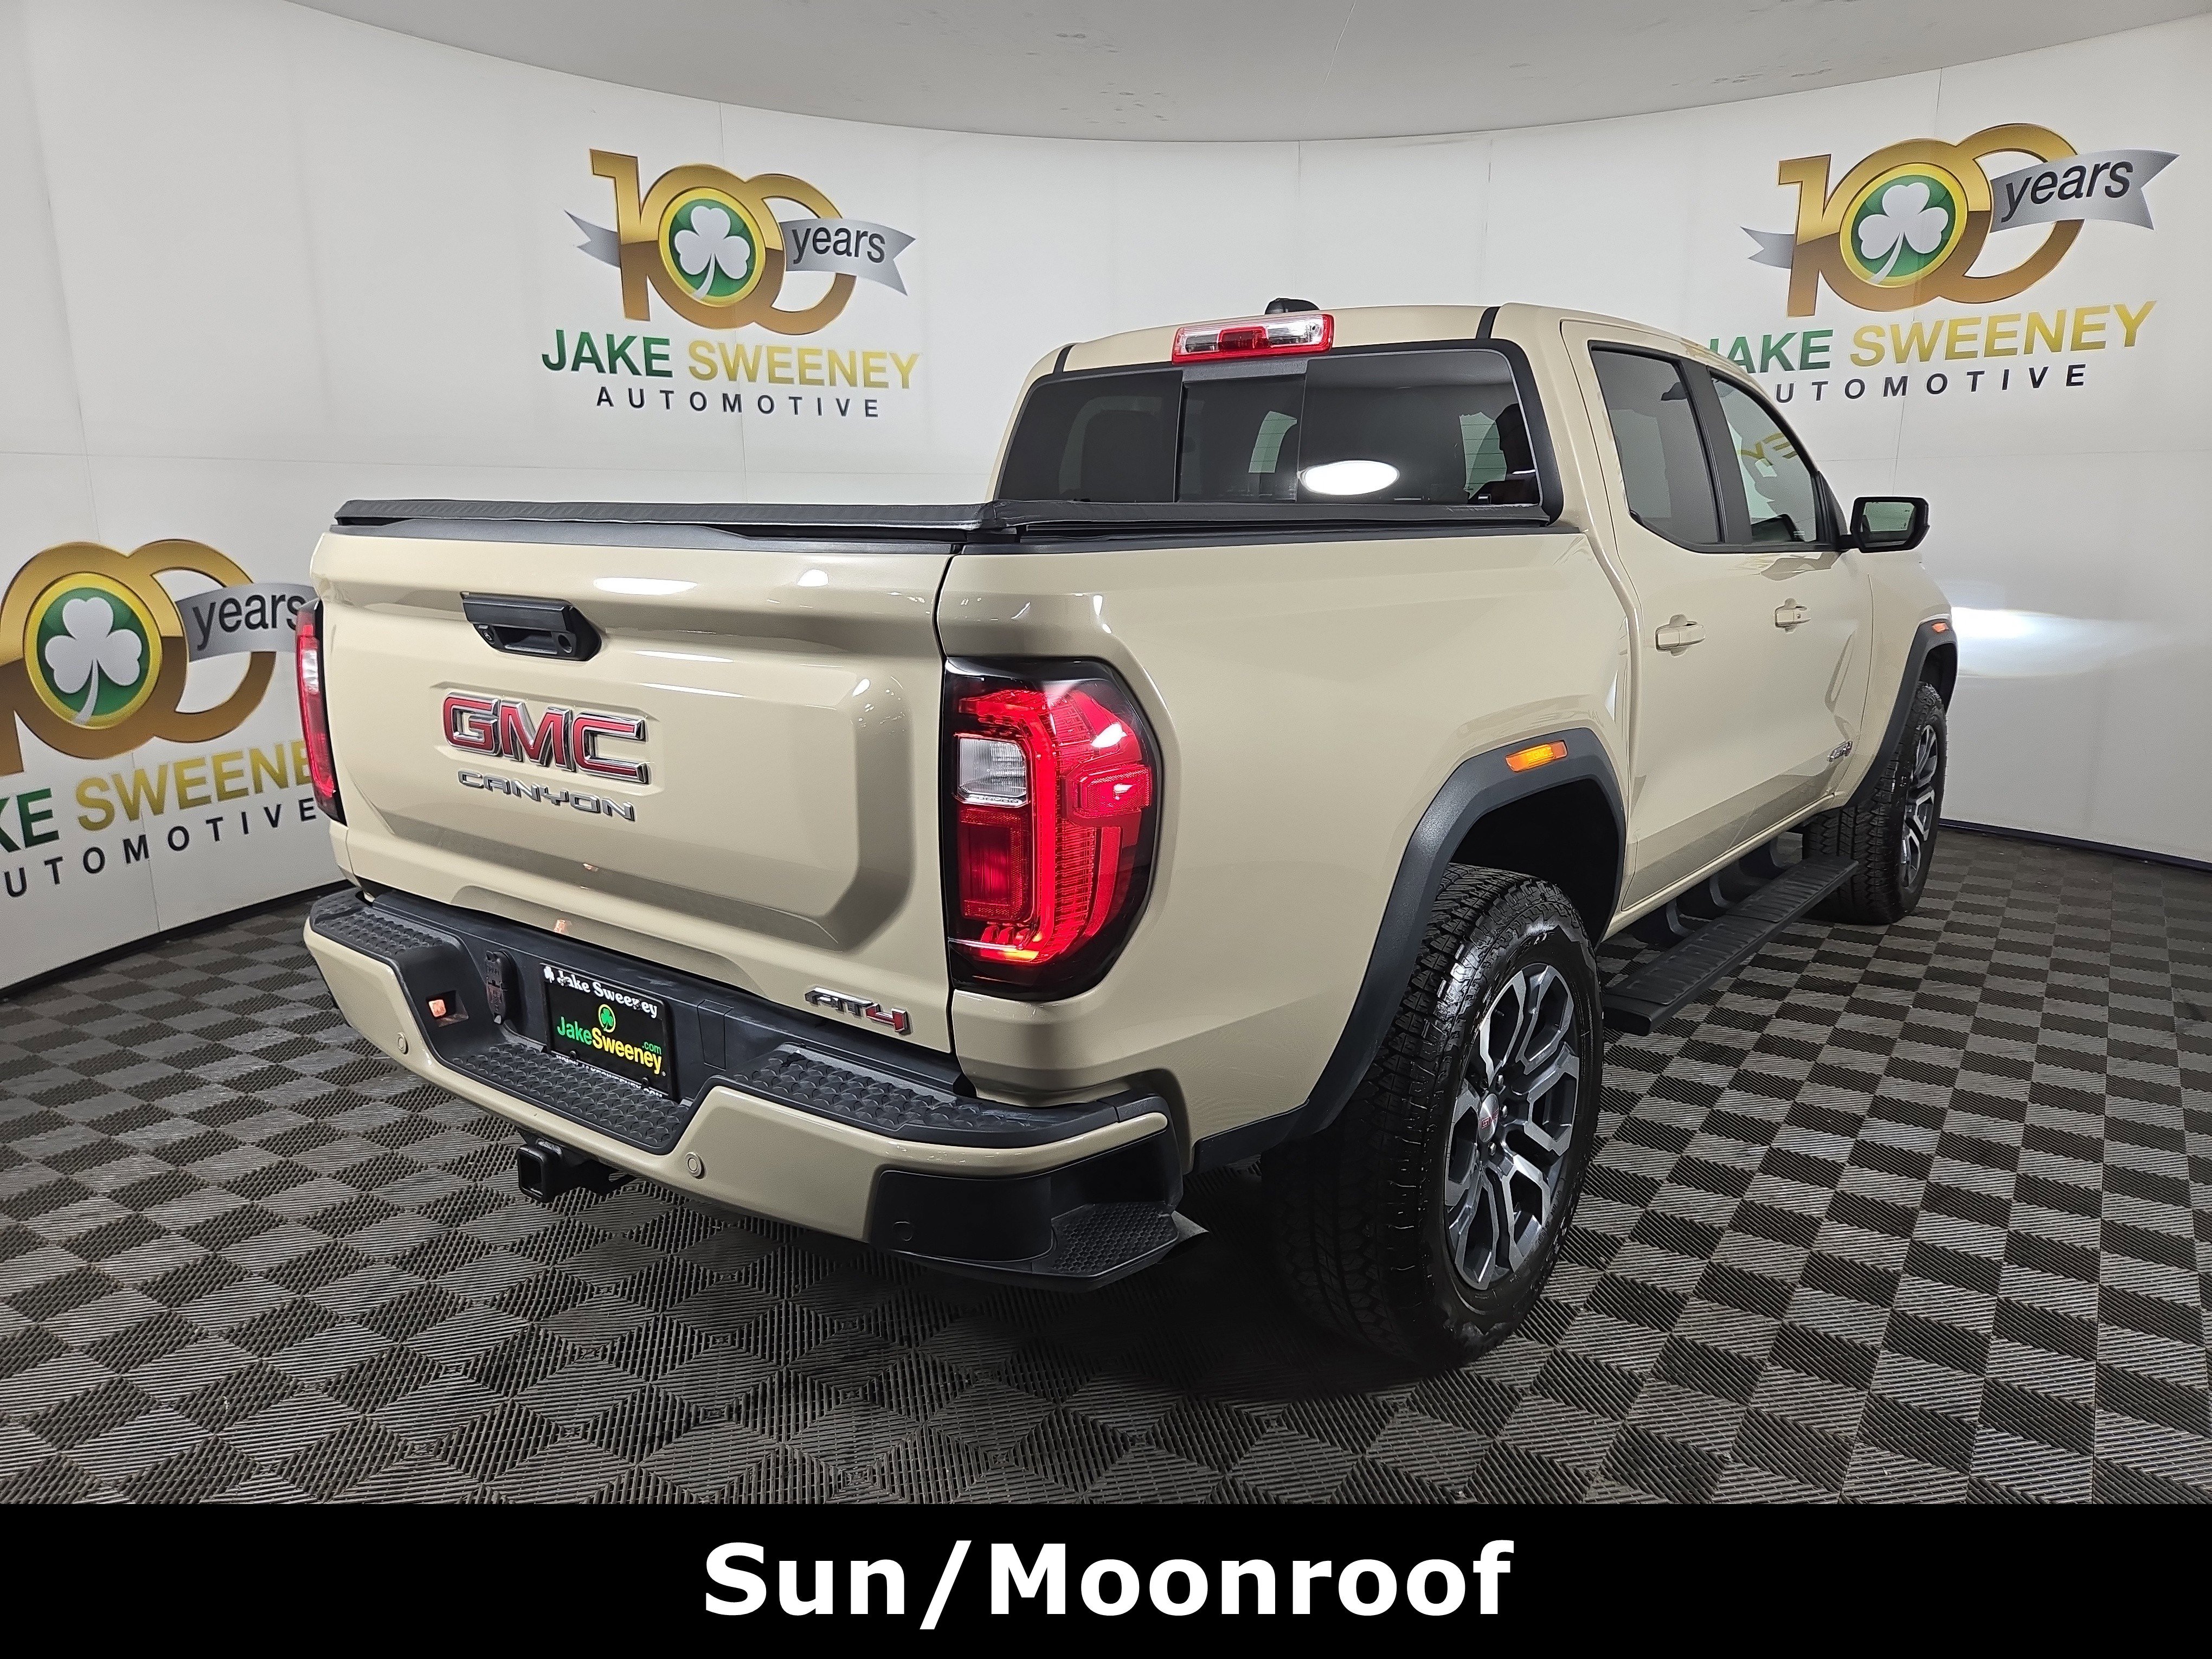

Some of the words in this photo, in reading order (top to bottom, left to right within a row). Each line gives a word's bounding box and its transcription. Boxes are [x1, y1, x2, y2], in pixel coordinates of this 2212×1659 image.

[589, 149, 857, 335] 100
[791, 225, 885, 265] years
[1777, 123, 2084, 317] 100
[2001, 159, 2133, 223] years
[542, 329, 673, 378] JAKE
[688, 339, 919, 389] SWEENEY
[1850, 300, 2156, 366] SWEENEY
[597, 387, 879, 417] AUTOMOTIVE
[1776, 364, 2086, 403] UTOMOTIVE
[443, 692, 651, 785] GMC
[75, 740, 311, 831] SWEENE
[458, 770, 635, 822] CANYON
[4, 798, 317, 898] UTOMOTIVE
[557, 970, 591, 993] Jake
[805, 987, 908, 1032] AT4
[642, 1041, 662, 1055] .com
